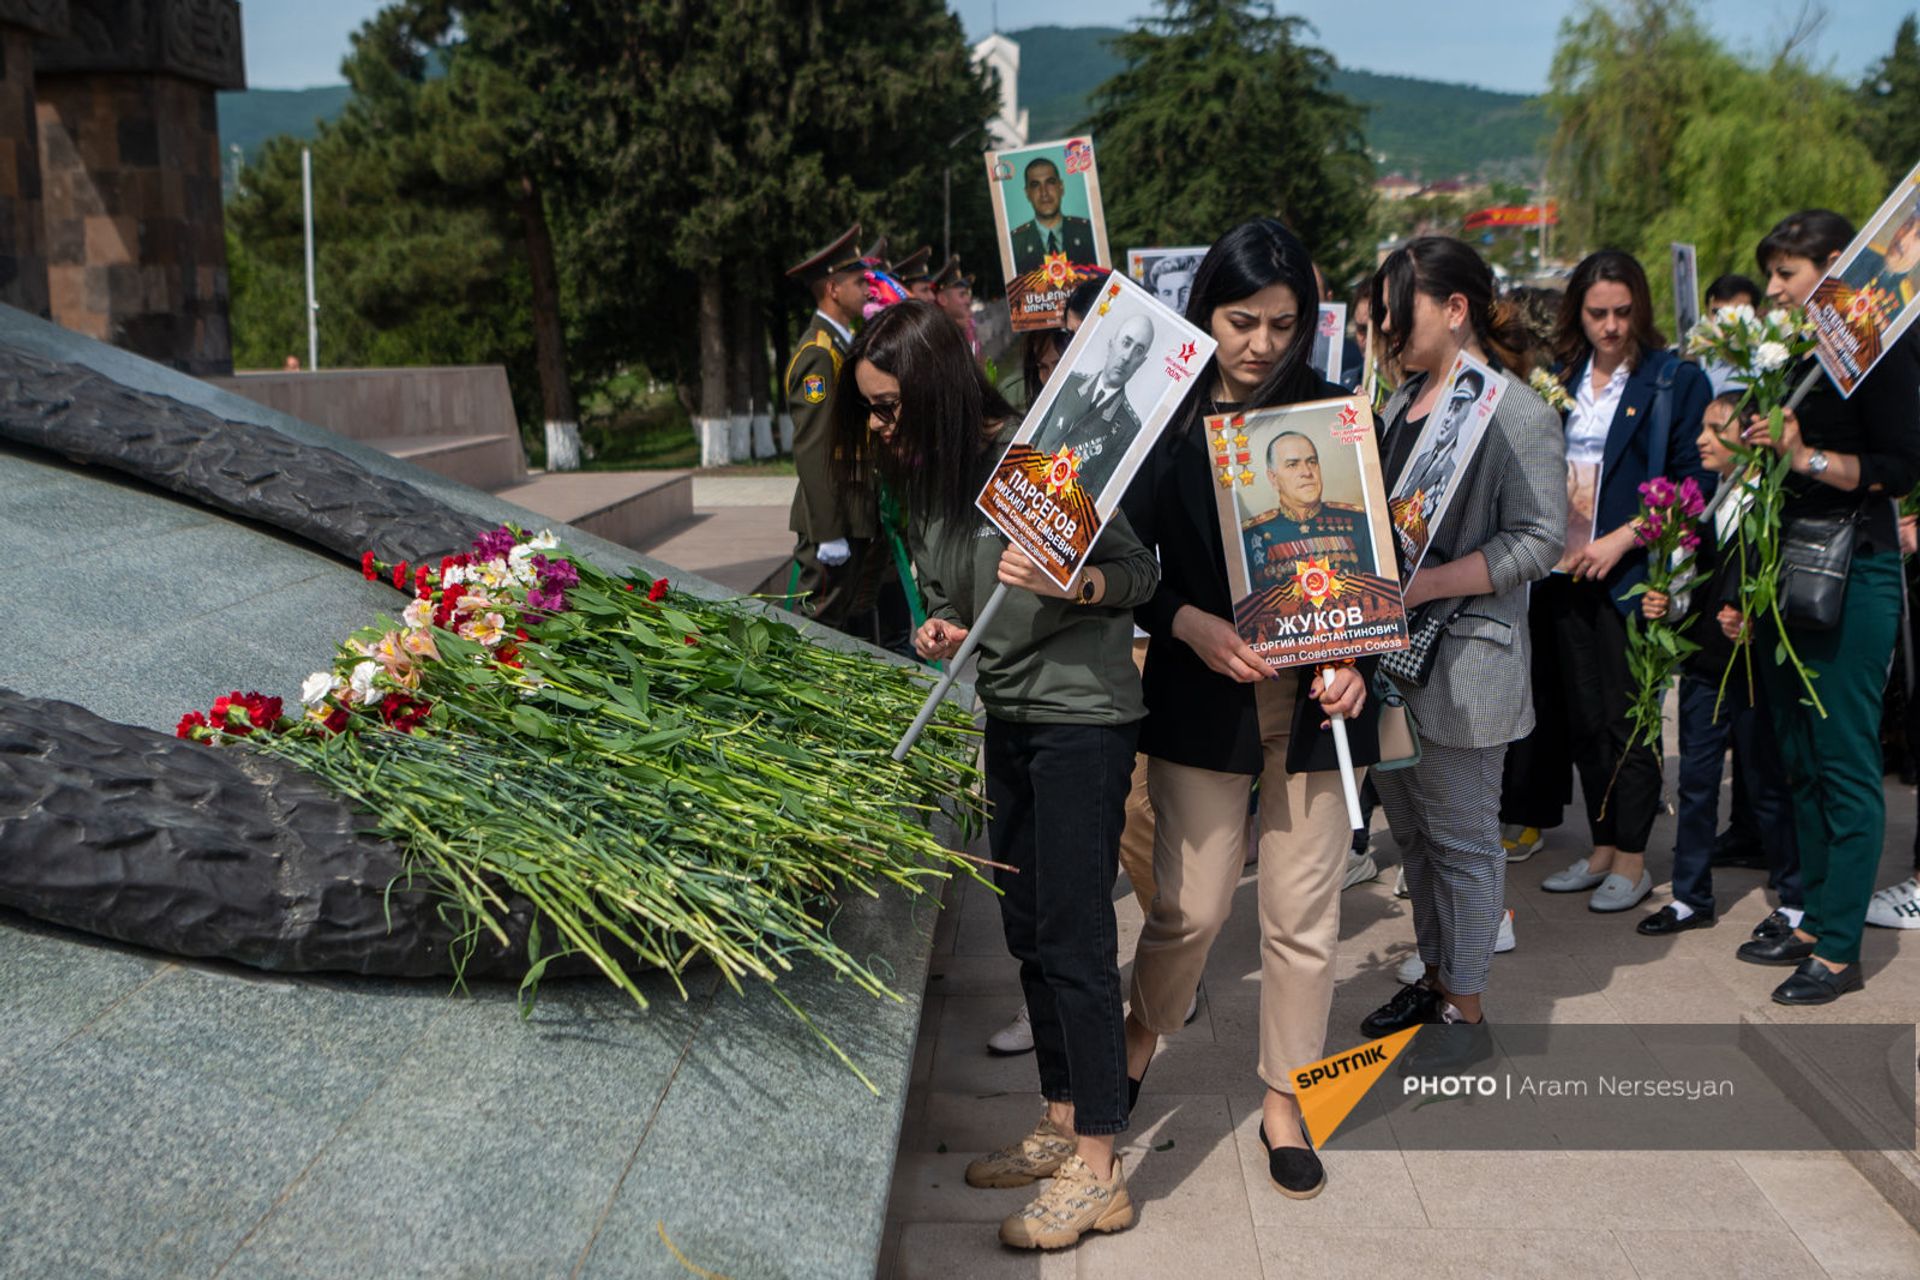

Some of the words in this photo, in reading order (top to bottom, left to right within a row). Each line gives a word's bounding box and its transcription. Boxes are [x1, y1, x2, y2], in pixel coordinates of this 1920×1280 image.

[994, 479, 1025, 512] МИХАИЛ
[1023, 508, 1077, 561] АРТЕМЬЕВИЧ
[1009, 470, 1077, 540] ПАРСЕГОВ
[1276, 606, 1363, 637] ЖУКОВ
[1298, 623, 1399, 646] КОНСТАНТИНОВИЧ
[1299, 645, 1362, 661] Советского
[1365, 639, 1402, 652] Союза
